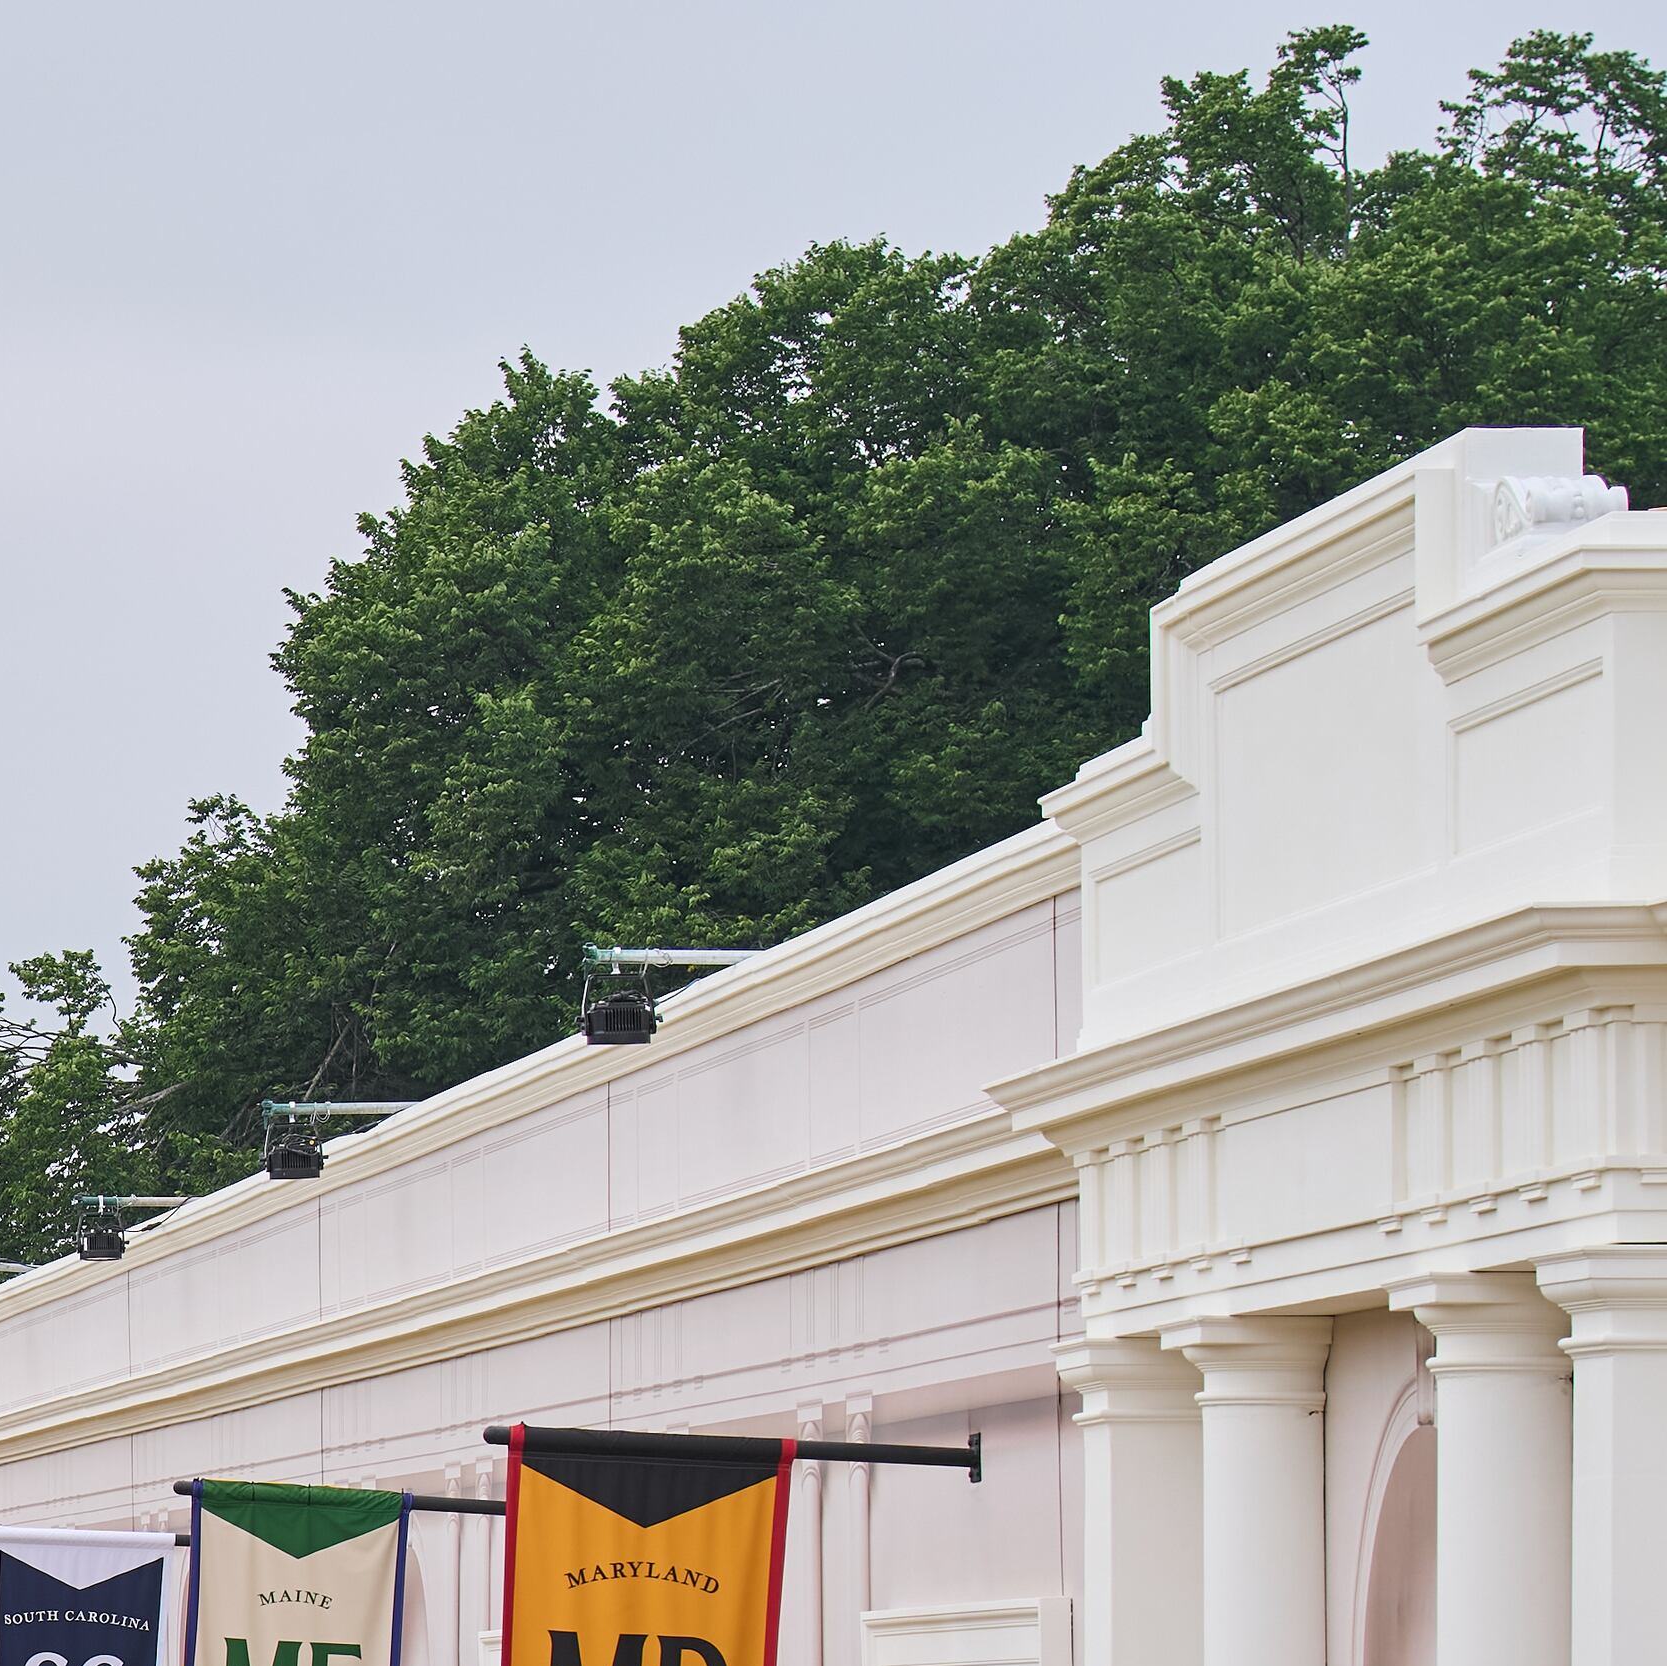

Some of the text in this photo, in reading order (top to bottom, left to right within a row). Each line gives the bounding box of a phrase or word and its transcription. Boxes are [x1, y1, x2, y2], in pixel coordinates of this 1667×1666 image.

[565, 1561, 720, 1595] MARYLAND
[257, 1589, 334, 1610] MAINE
[4, 1609, 151, 1632] SOUTH CAROLINA
